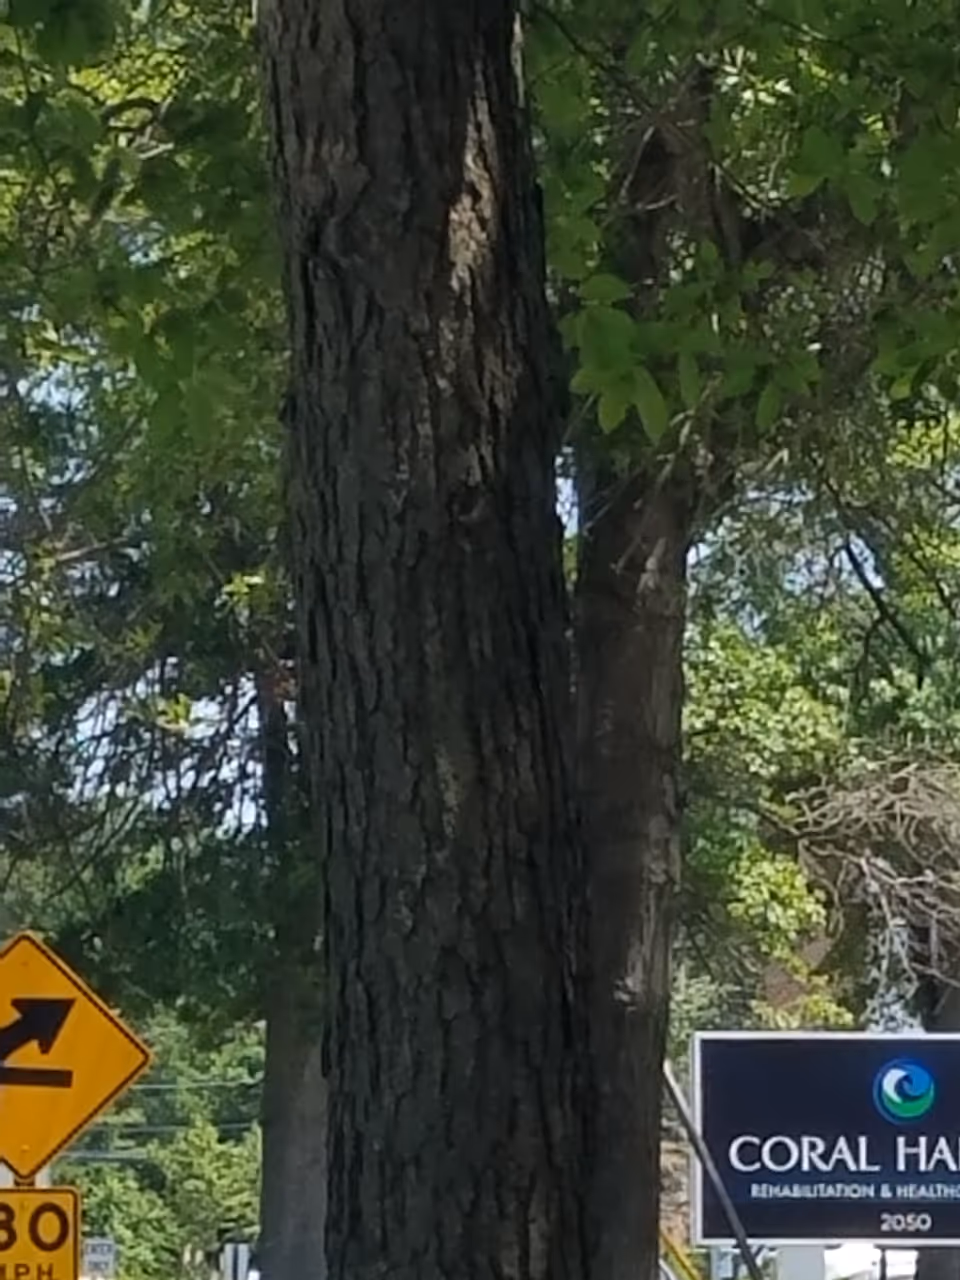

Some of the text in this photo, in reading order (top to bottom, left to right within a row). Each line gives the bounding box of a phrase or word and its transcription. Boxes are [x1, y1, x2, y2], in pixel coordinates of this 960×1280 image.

[728, 1135, 881, 1172] CORAL
[750, 1183, 875, 1198] REHABILITATION
[880, 1183, 893, 1198] &
[879, 1213, 933, 1231] 2050
